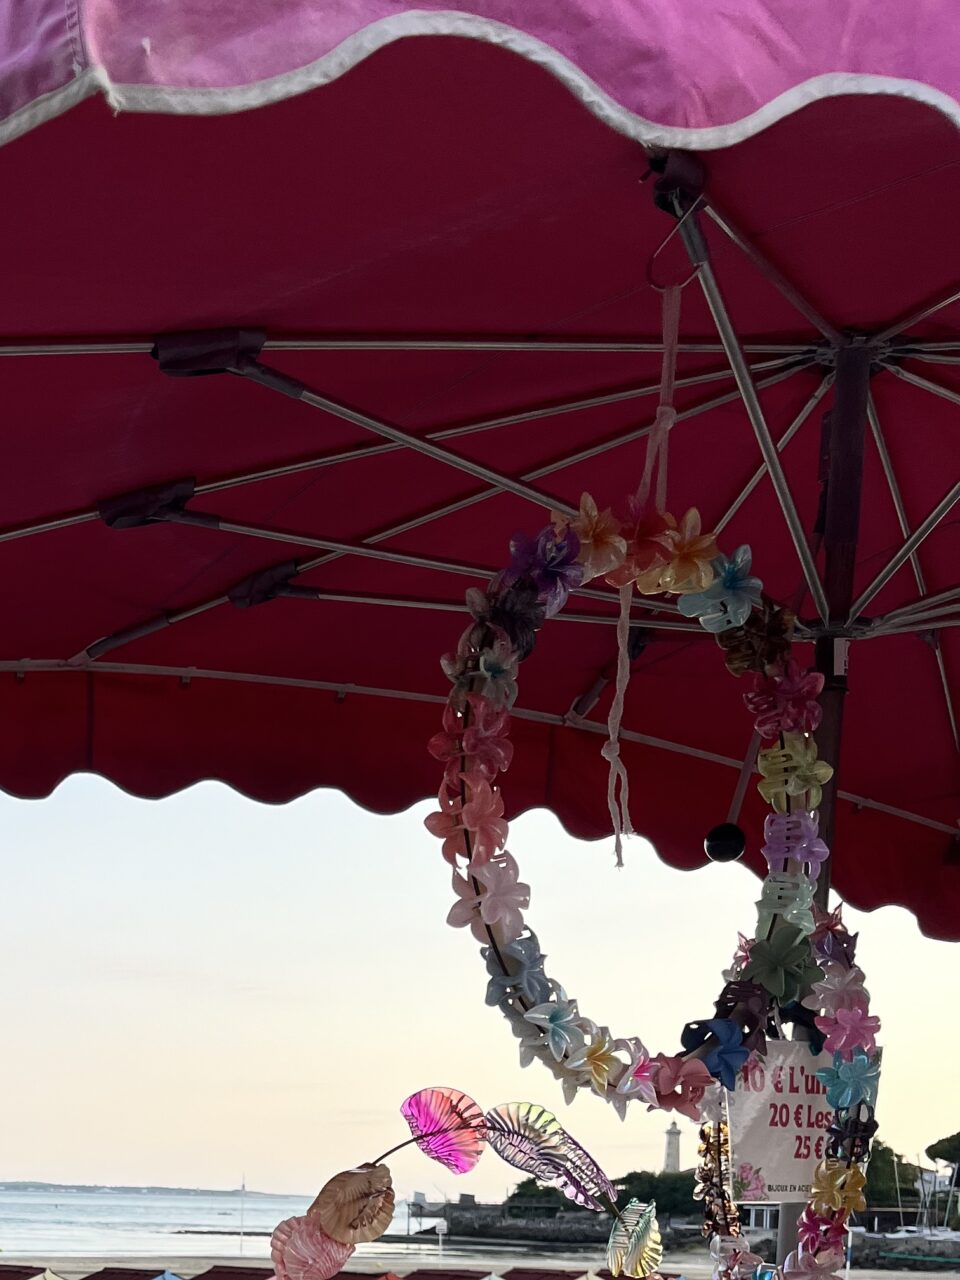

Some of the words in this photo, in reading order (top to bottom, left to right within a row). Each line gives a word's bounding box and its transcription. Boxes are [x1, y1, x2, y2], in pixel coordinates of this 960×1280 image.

[741, 1065, 765, 1093] 10
[771, 1065, 784, 1094] €
[768, 1103, 790, 1128] 20
[794, 1104, 804, 1129] €
[806, 1104, 833, 1129] Les
[793, 1135, 811, 1160] 25
[814, 1135, 825, 1160] €
[789, 1184, 797, 1193] EN
